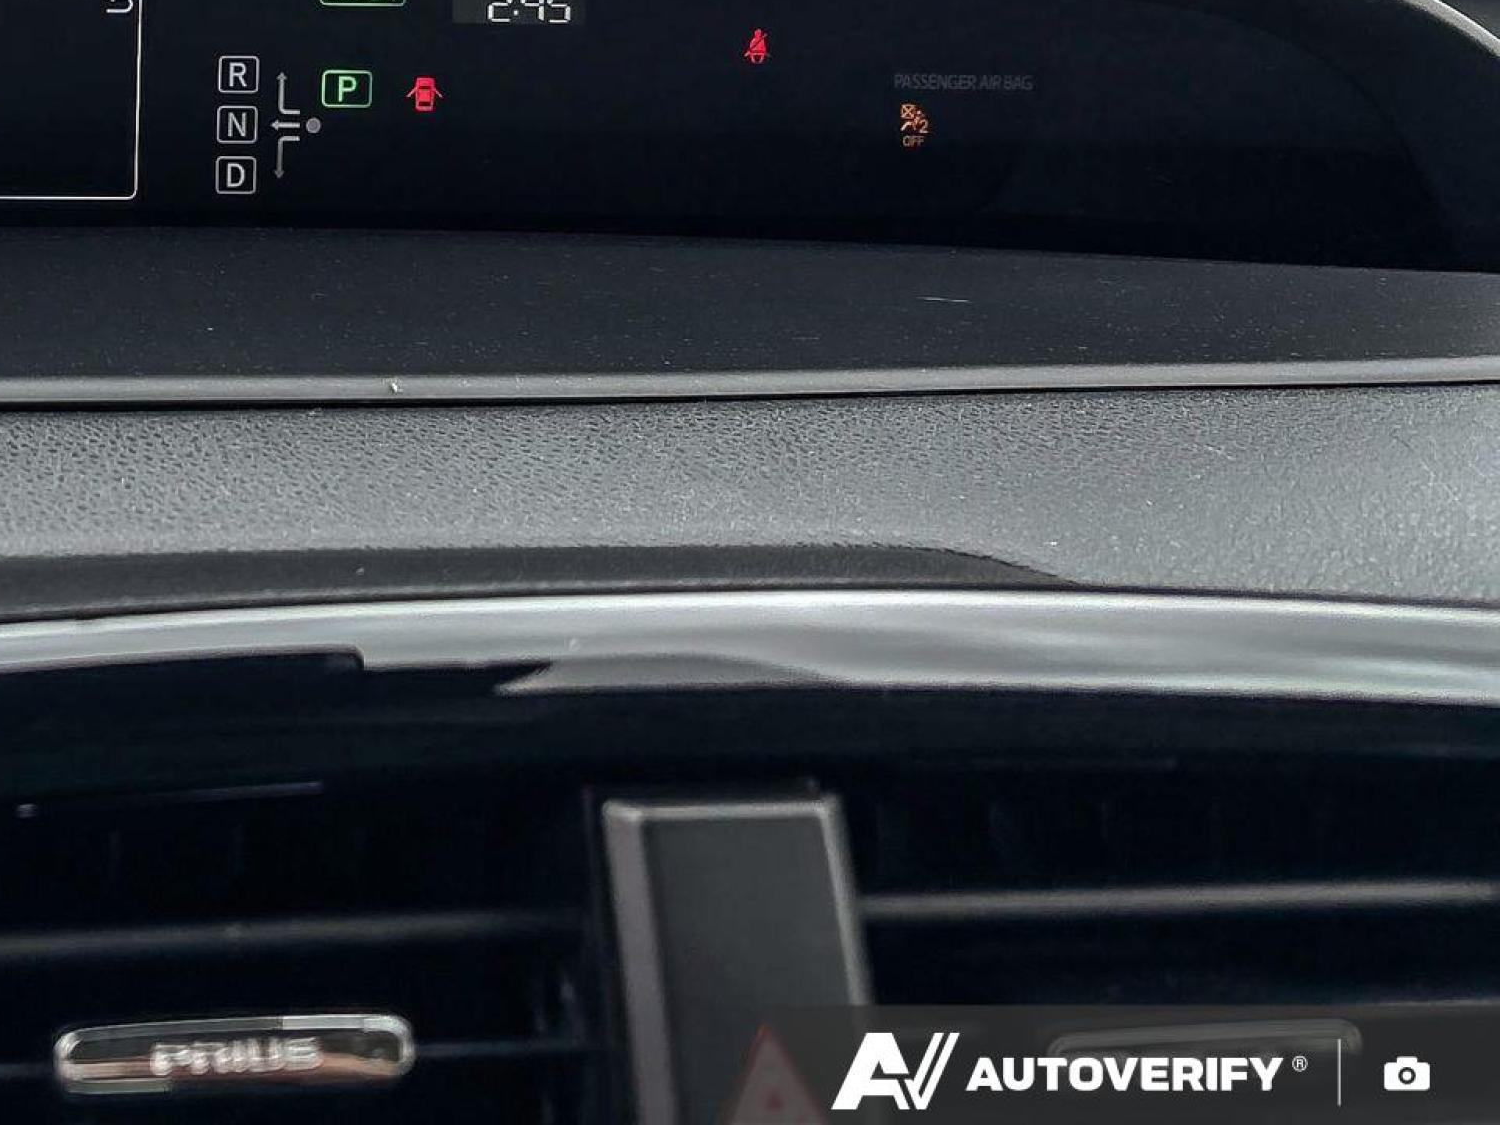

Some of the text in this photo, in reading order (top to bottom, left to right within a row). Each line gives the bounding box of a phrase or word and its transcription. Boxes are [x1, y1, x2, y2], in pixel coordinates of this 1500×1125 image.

[228, 62, 247, 88] R
[894, 74, 977, 91] PASSENGER
[338, 76, 357, 103] P
[227, 112, 246, 138] N
[902, 135, 925, 148] OFF
[226, 163, 246, 189] D
